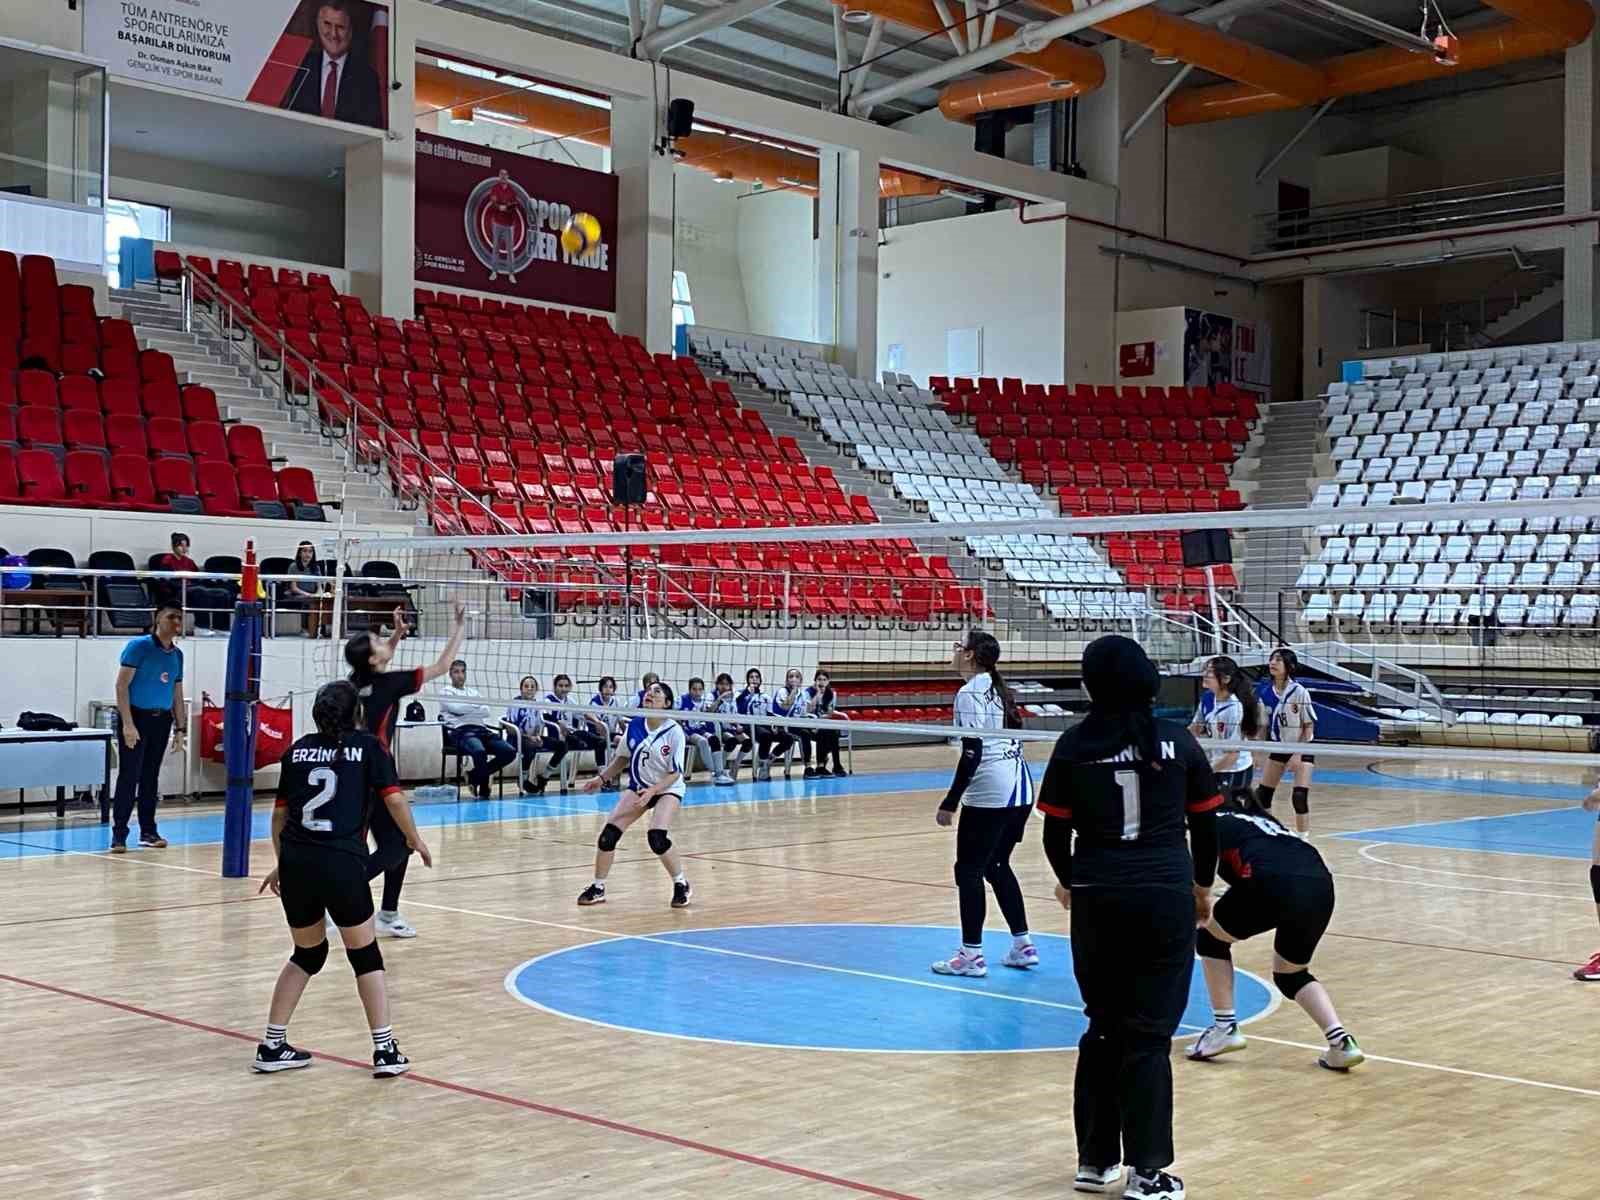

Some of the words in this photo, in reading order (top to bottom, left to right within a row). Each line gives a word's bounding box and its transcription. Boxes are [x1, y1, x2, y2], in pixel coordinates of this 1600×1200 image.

[120, 1, 147, 18] TÜM
[150, 9, 213, 33] ANTRENÖR
[215, 23, 229, 37] VE
[124, 16, 225, 48] SPORCULARIMIZA
[117, 30, 174, 51] BAŞARILAR
[176, 43, 231, 64] DİLİYORUM
[527, 230, 558, 262] HER
[292, 746, 363, 763] ERZİNAN
[302, 766, 338, 832] 2
[1114, 769, 1140, 840] 1
